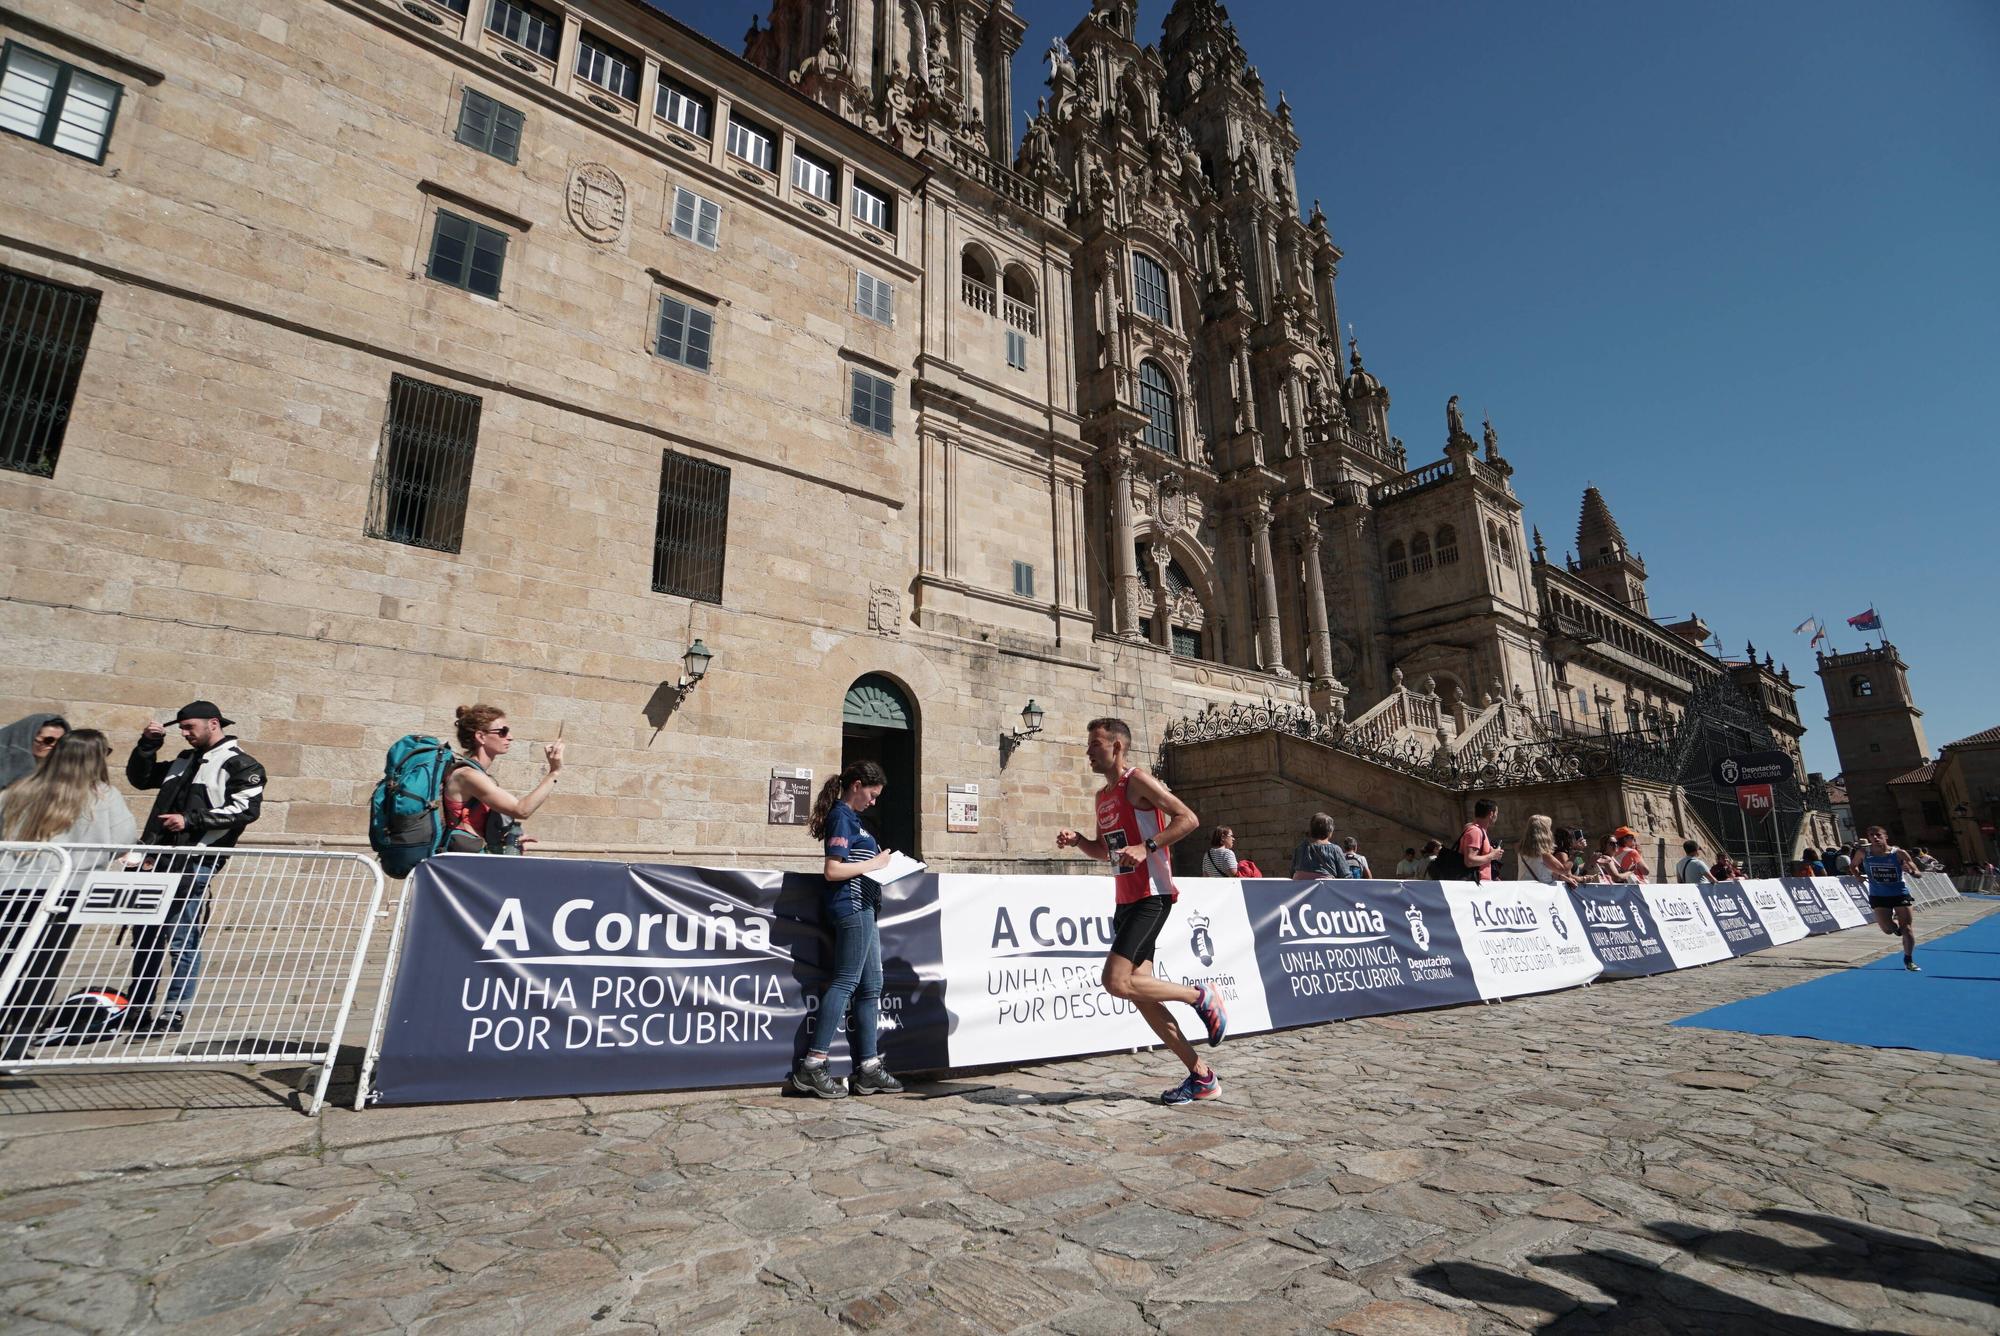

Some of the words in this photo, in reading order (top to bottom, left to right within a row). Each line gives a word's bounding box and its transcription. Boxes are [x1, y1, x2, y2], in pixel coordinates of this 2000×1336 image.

[1743, 794, 1769, 809] 75M
[482, 898, 528, 952] A
[552, 897, 771, 952] Coruña
[991, 906, 1020, 949] A
[1029, 906, 1116, 947] Coru
[1279, 904, 1298, 938] A
[1299, 903, 1386, 936] Coruña
[1470, 900, 1486, 927] A
[1485, 900, 1538, 926] Coruña
[1280, 950, 1327, 974] UNHA
[1327, 945, 1401, 970] PROVINCIA
[1407, 954, 1452, 971] Deputación
[1411, 970, 1424, 982] DA
[1423, 966, 1455, 980] CORUÑA
[461, 976, 577, 1012] UNHA
[591, 973, 785, 1010] PROVINCIA
[987, 967, 1057, 995] UNHA
[1291, 975, 1324, 998] POR
[1325, 967, 1404, 994] DESCUBRIR
[998, 996, 1046, 1025] POR
[467, 1016, 551, 1053] POR
[565, 1011, 776, 1050] DESCUBRIR
